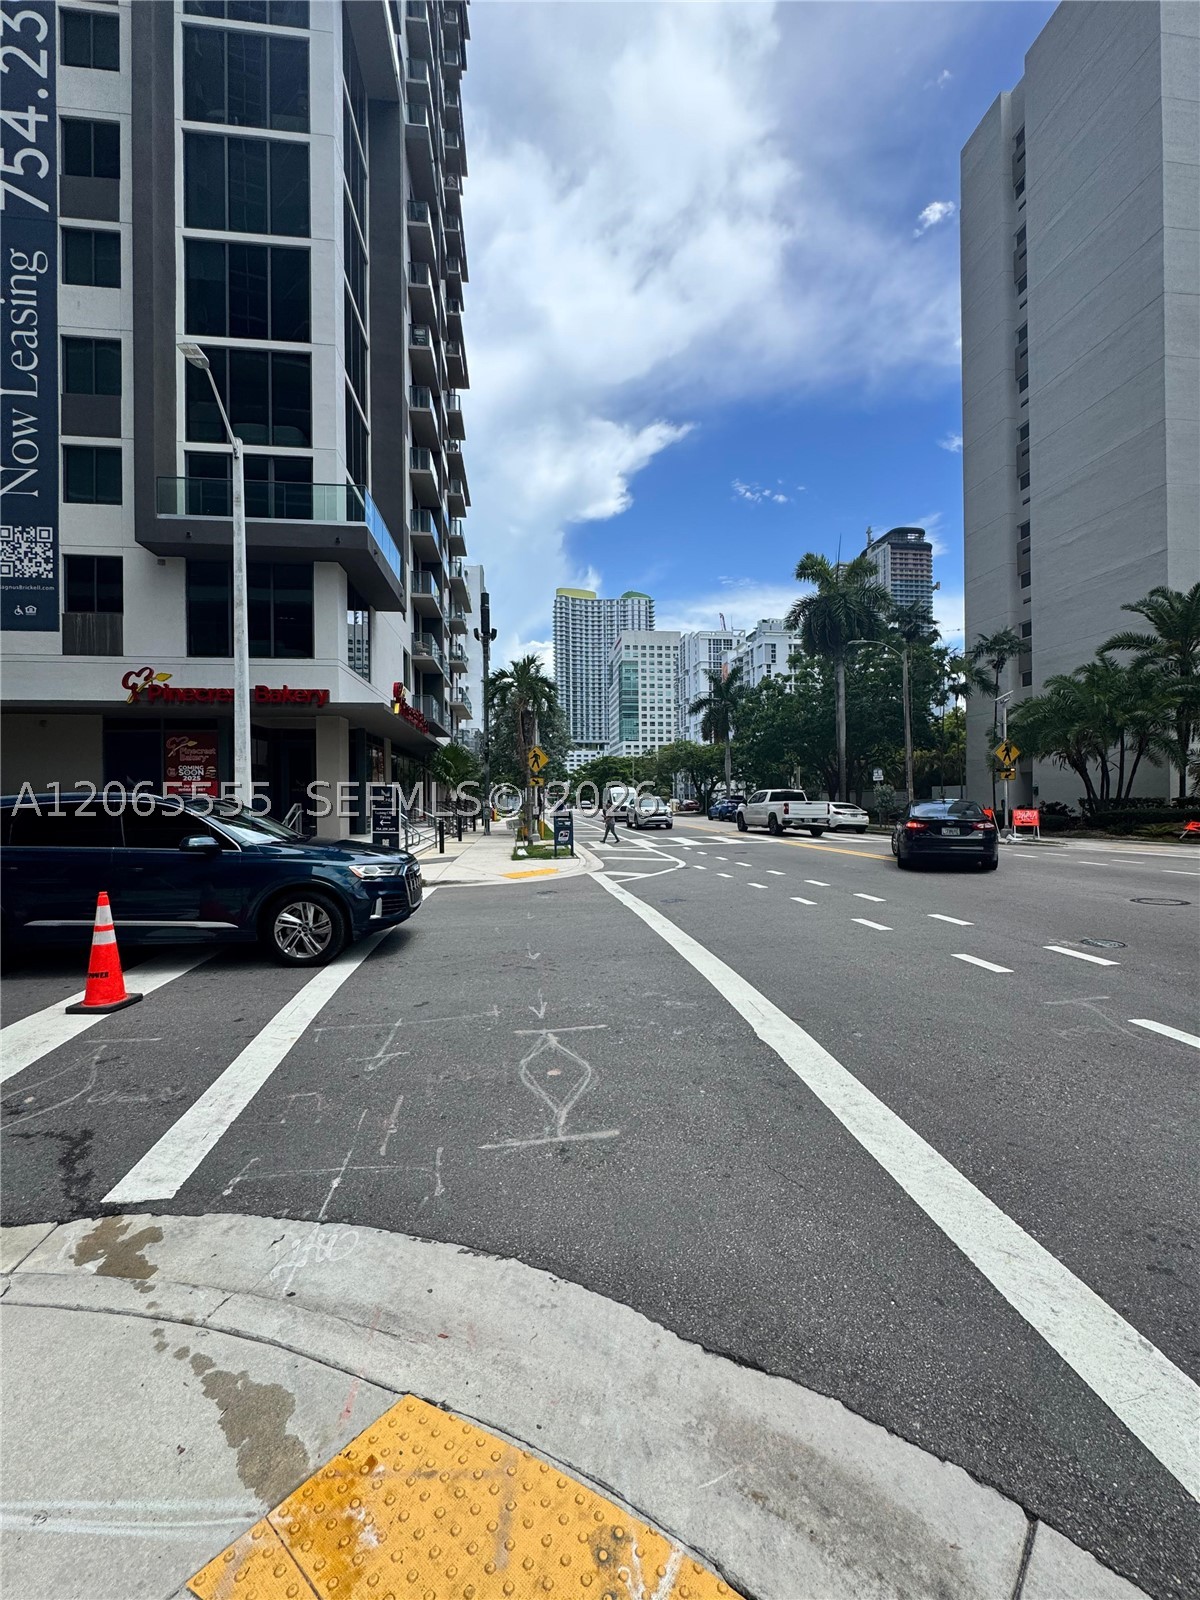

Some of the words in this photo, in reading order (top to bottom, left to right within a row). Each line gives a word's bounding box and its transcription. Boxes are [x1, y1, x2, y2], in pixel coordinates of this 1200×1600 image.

[0, 247, 49, 398] Leasing
[0, 408, 40, 497] Now
[0, 584, 55, 592] agnusBrickell.com
[148, 683, 234, 704] Pinecre
[255, 685, 330, 708] Bakery
